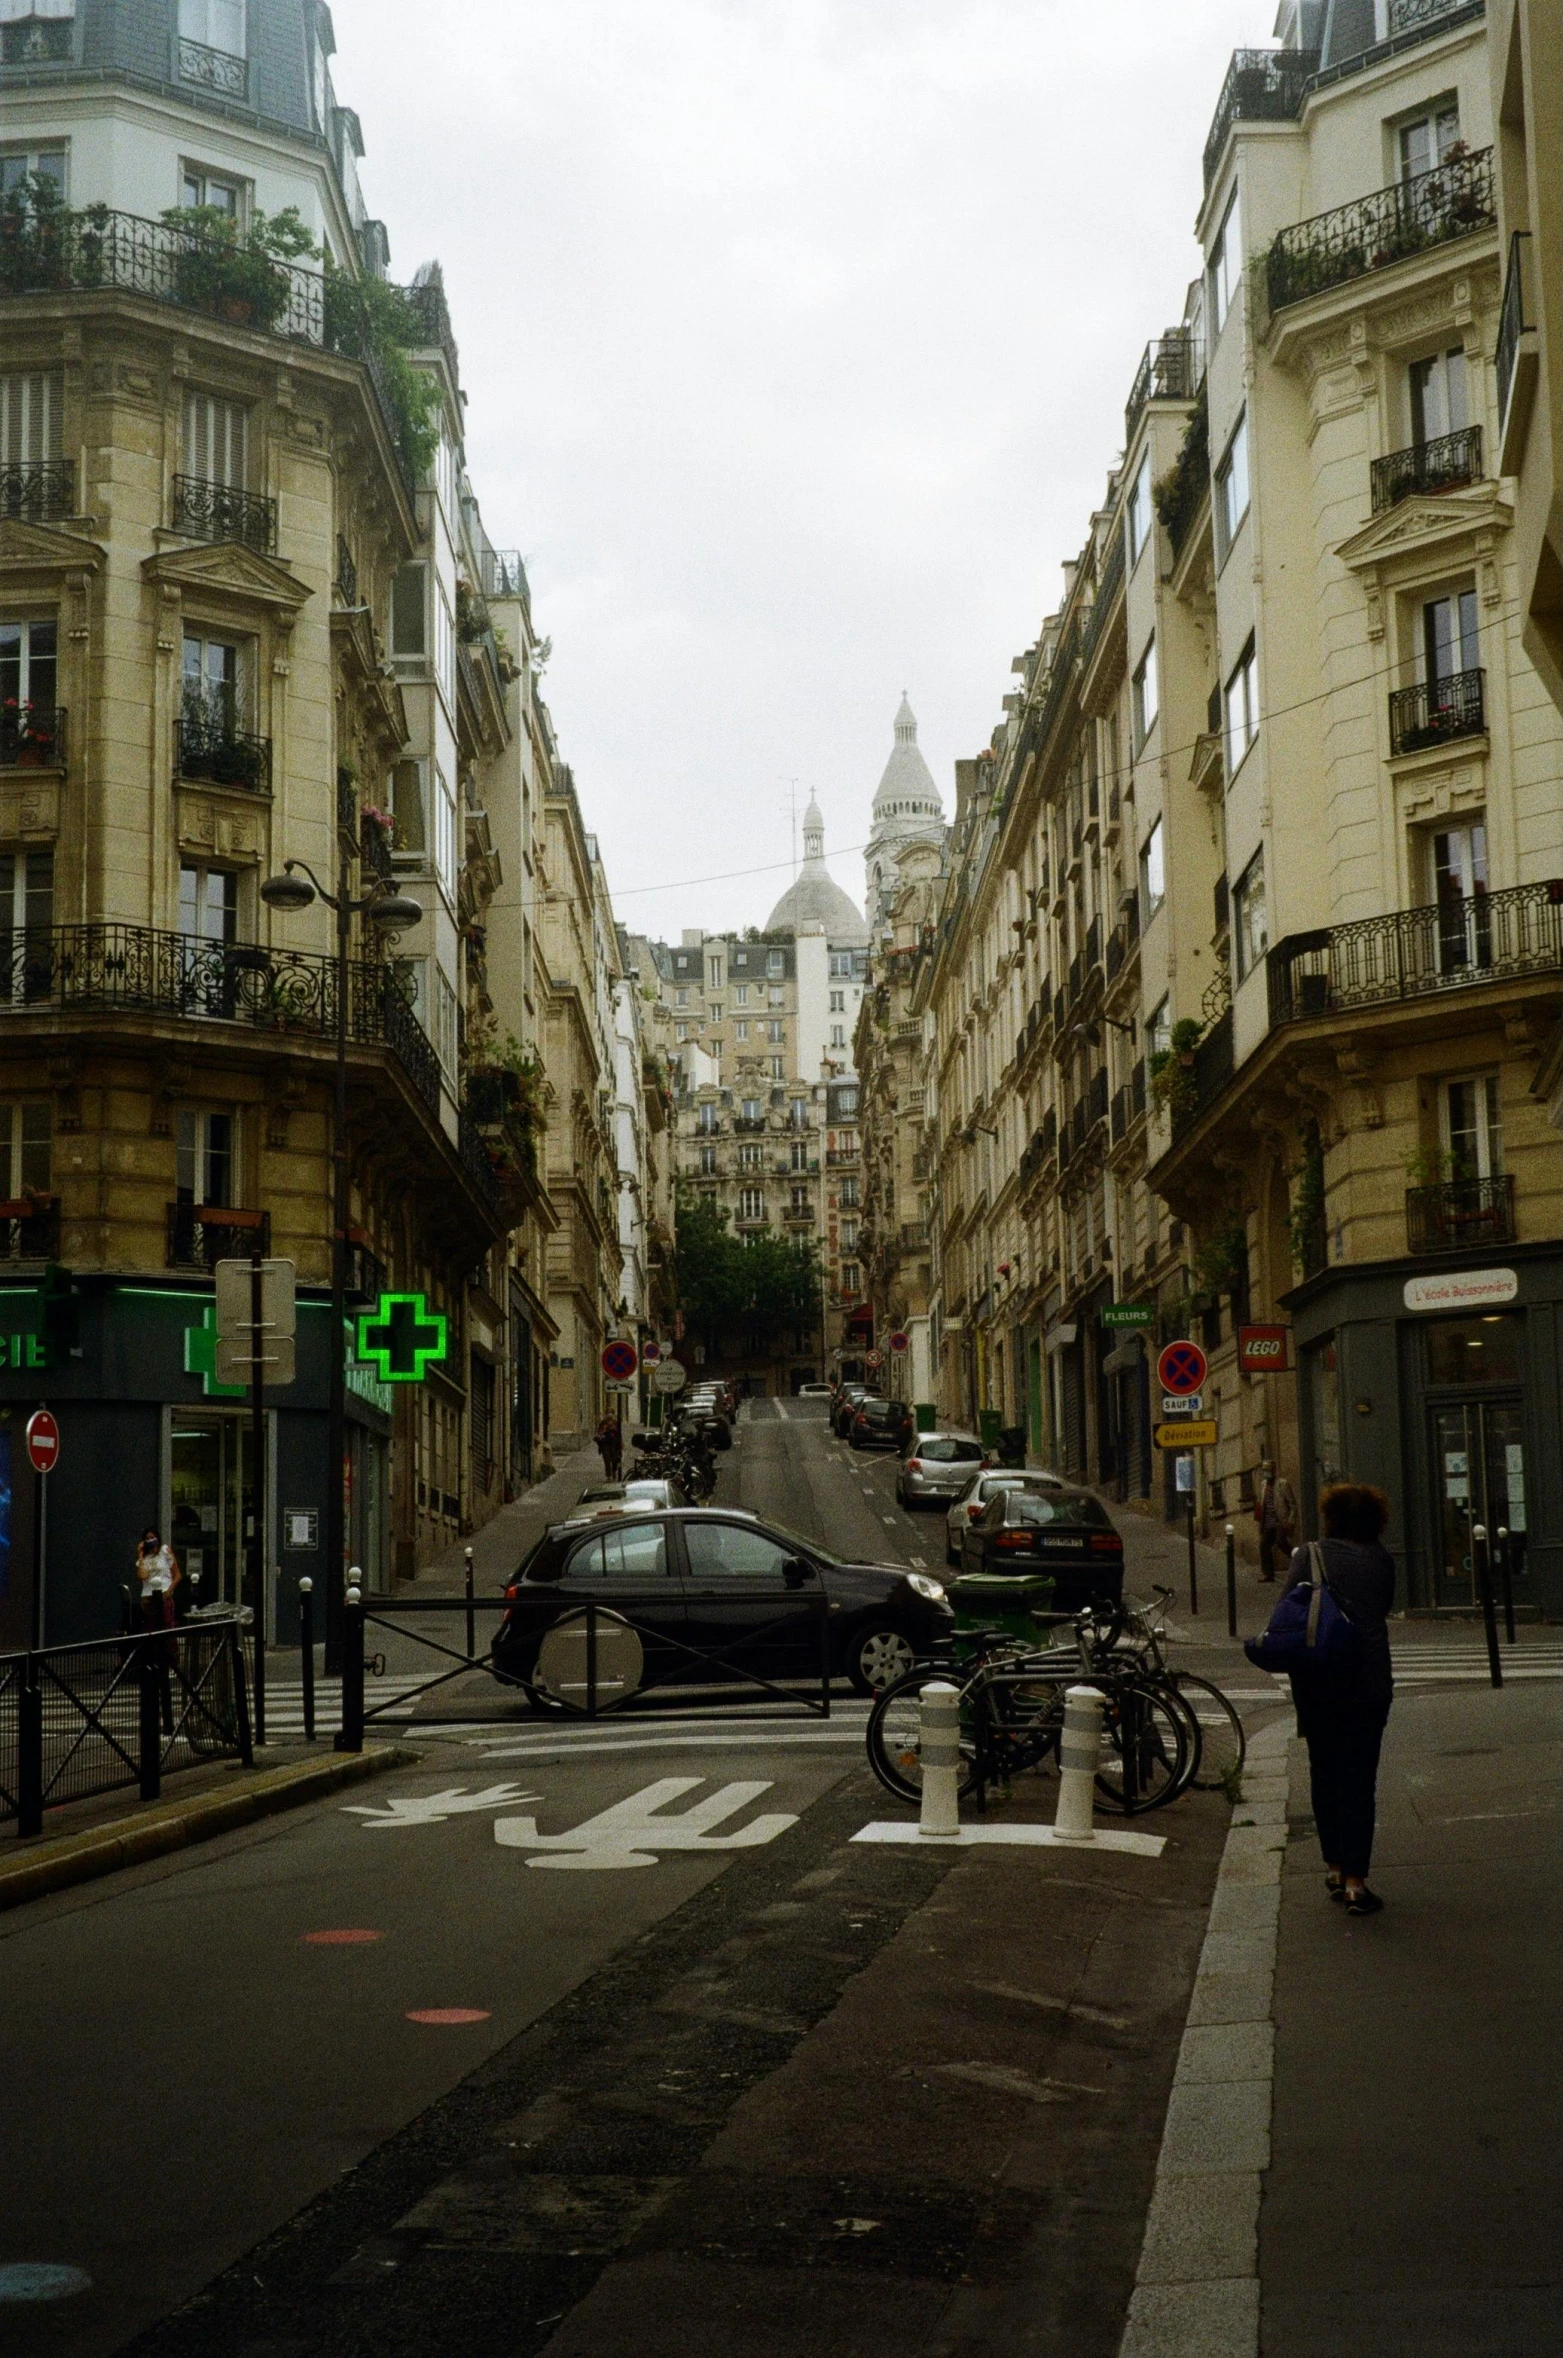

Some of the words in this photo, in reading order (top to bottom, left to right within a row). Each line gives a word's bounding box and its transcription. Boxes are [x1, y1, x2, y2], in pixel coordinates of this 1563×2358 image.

[1105, 1312, 1148, 1321] FLEURS
[1245, 1341, 1280, 1355] LEGO
[1165, 1401, 1187, 1409] SAUF
[1165, 1430, 1206, 1441] Déviation
